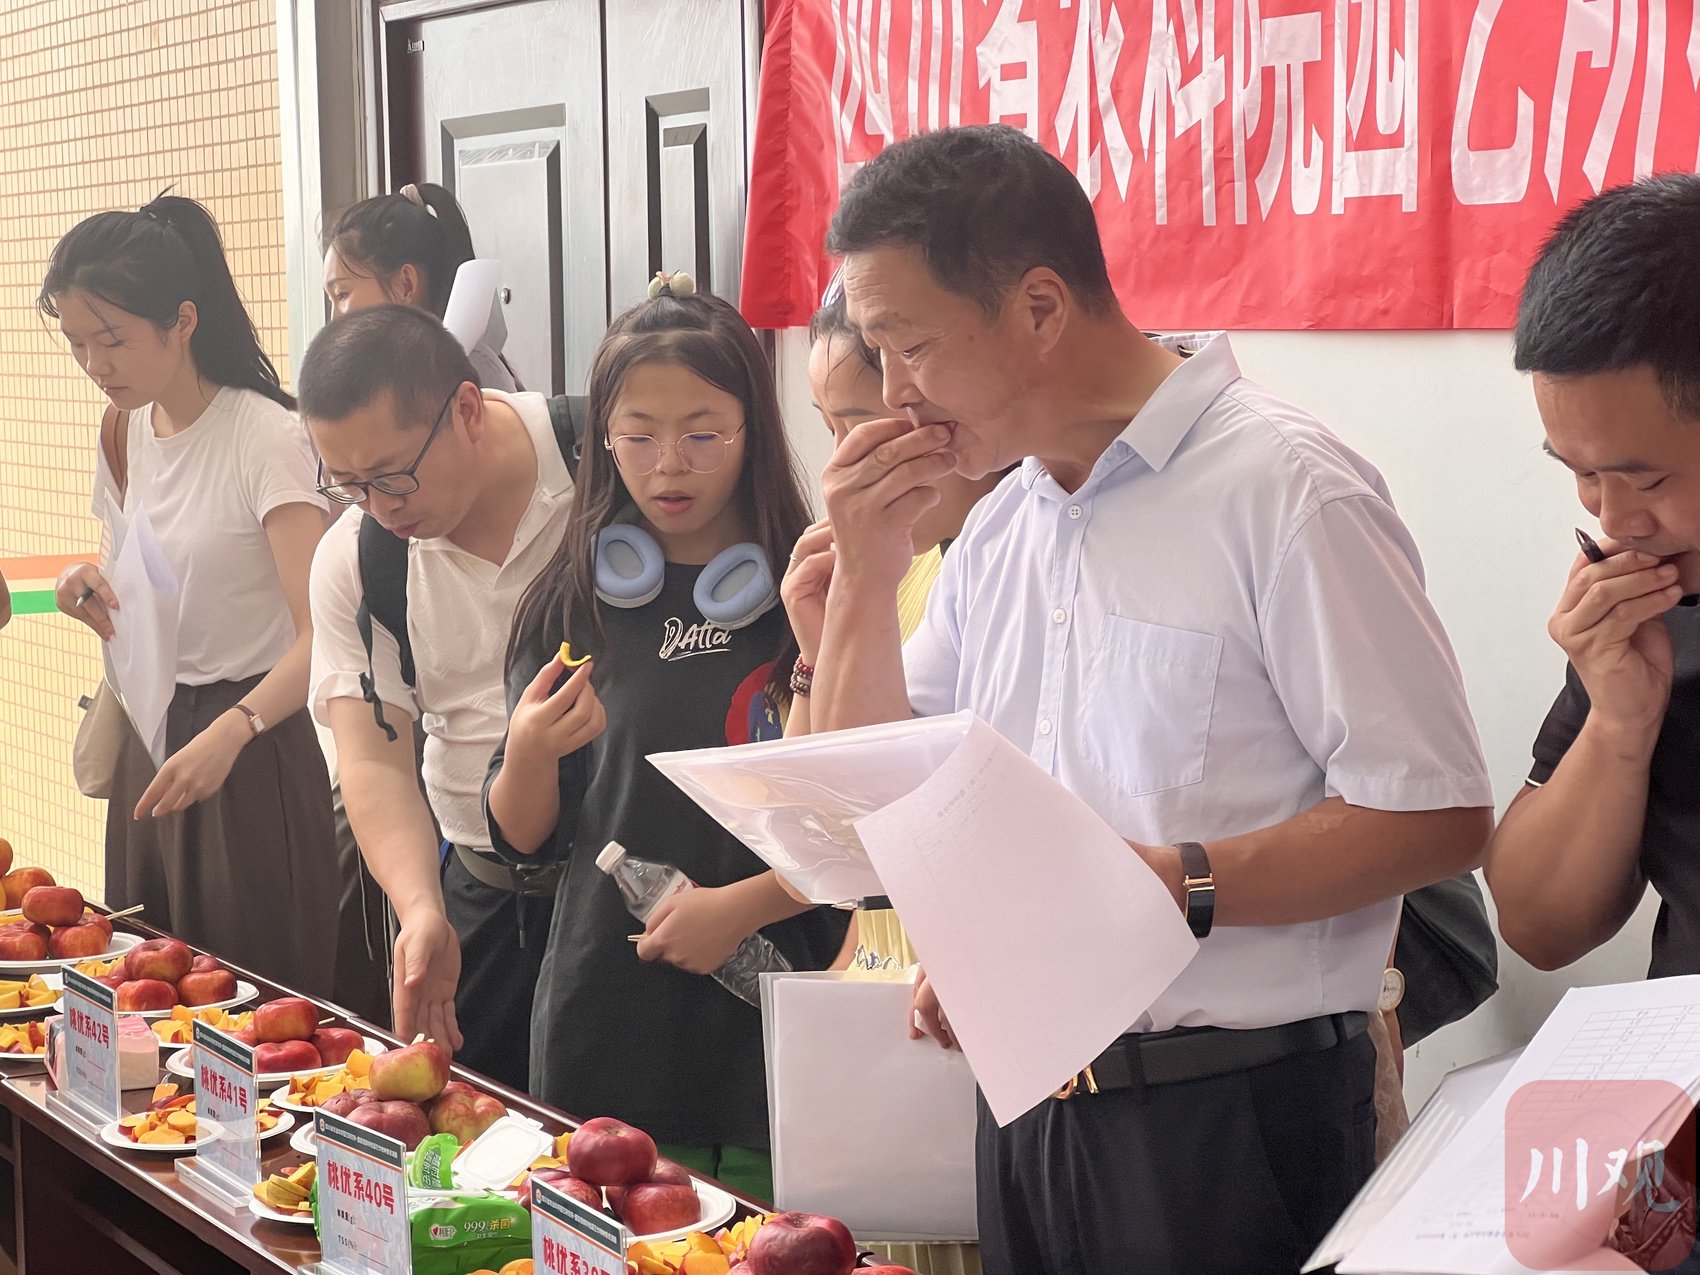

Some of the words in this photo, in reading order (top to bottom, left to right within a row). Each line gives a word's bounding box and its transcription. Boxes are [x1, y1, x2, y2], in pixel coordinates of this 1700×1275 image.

[69, 1006, 109, 1049] 桃优系42号
[200, 1064, 248, 1115] 桃优系41号
[326, 1159, 395, 1215] 桃优系40号
[463, 1220, 486, 1232] 999
[543, 1235, 612, 1275] 桃优系3
